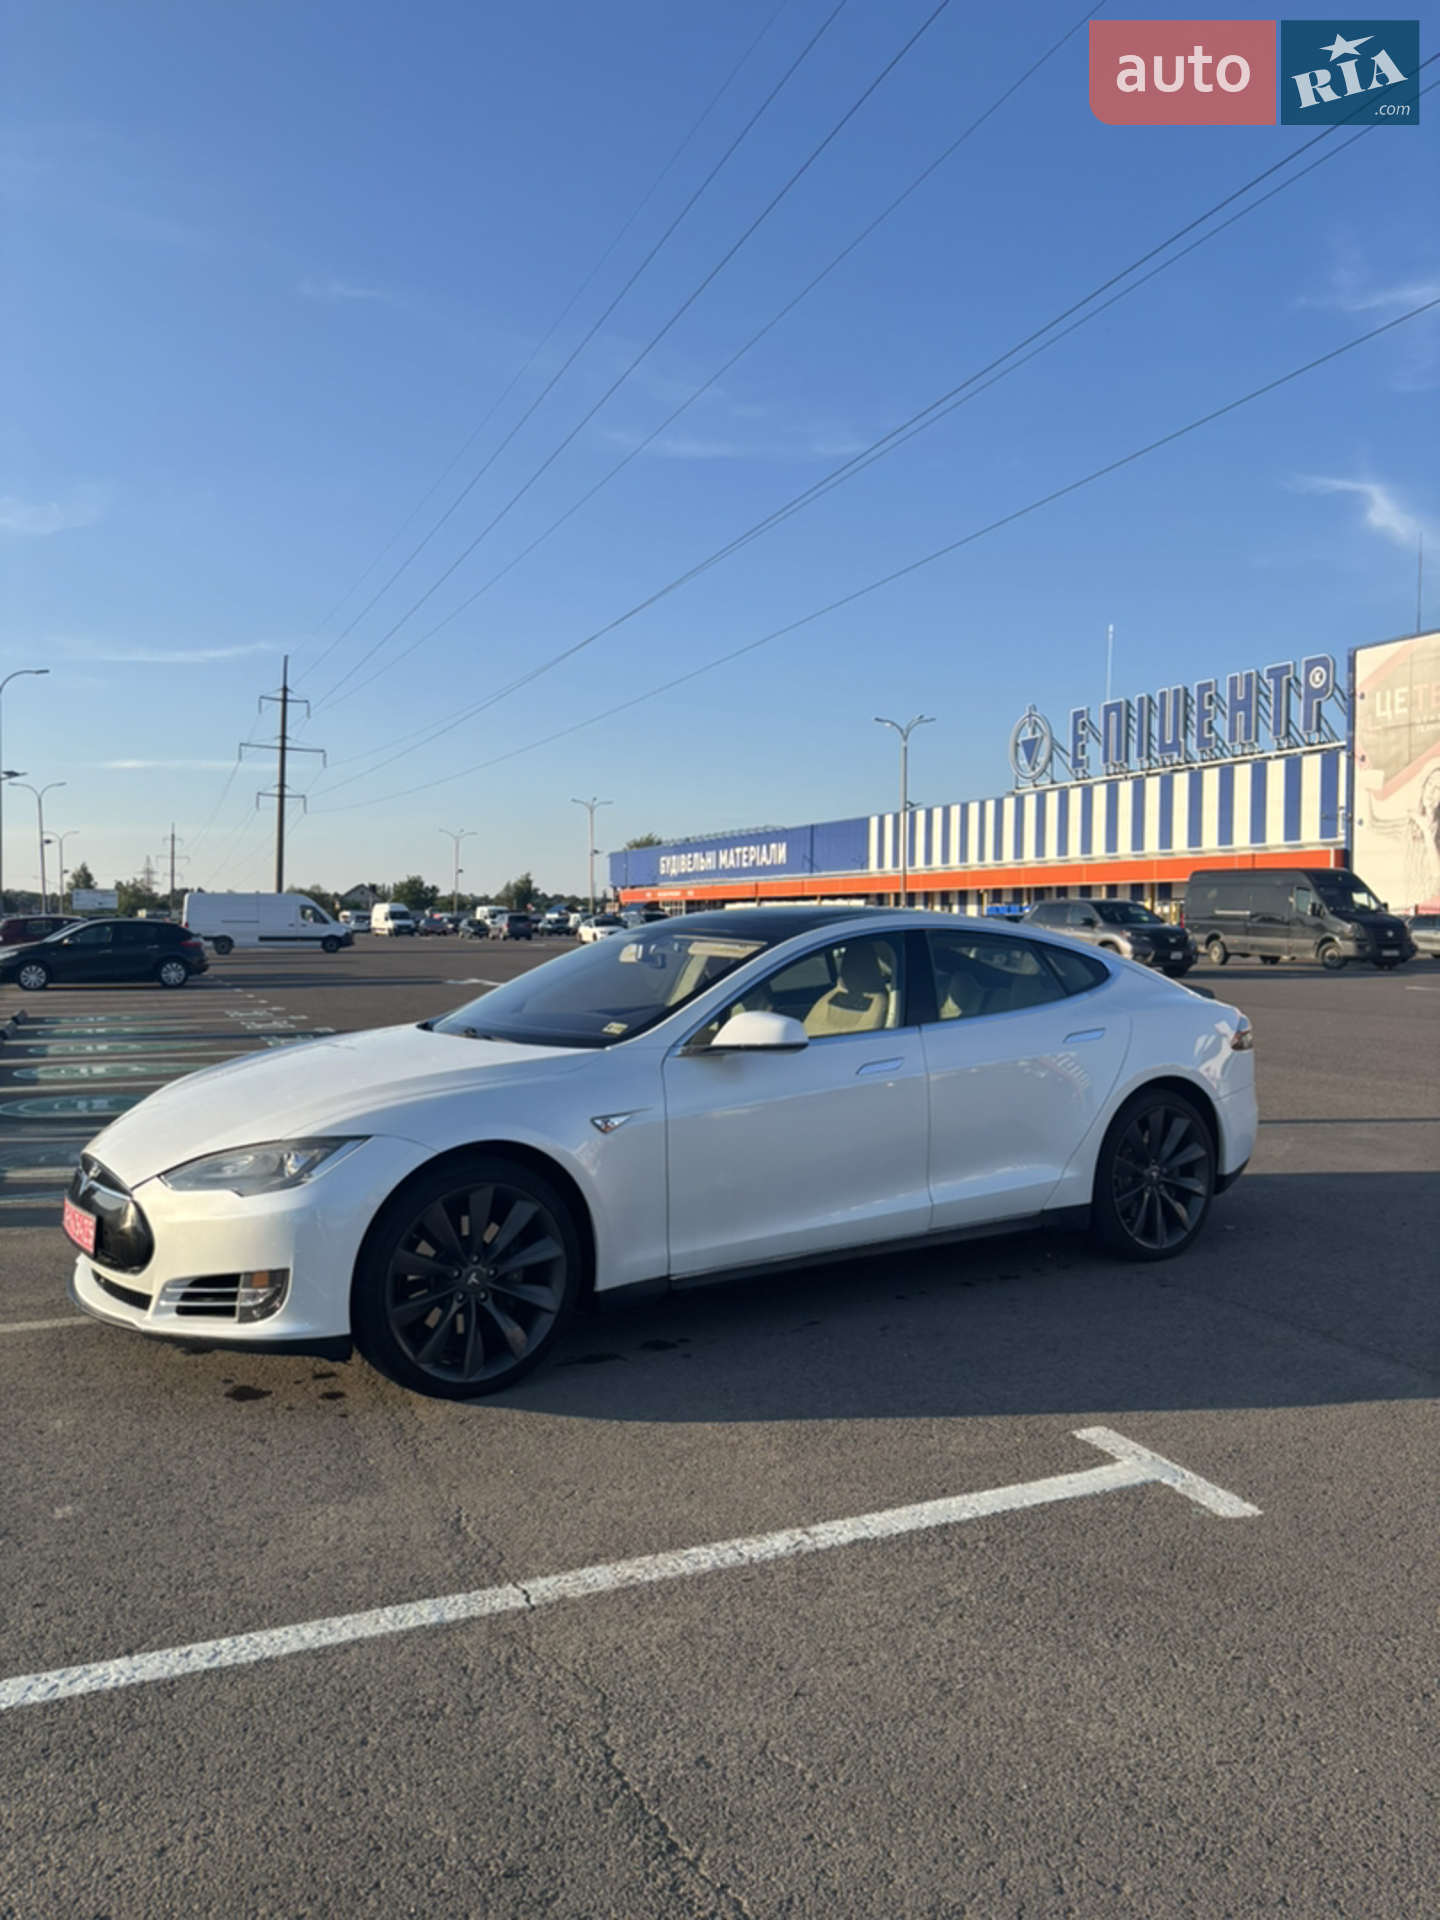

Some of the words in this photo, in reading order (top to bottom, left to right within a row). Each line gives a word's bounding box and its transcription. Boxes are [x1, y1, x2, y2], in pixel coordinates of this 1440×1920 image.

[1070, 653, 1335, 771] ЕПІЦЕНТР
[1376, 686, 1409, 720] ЦЕ
[659, 850, 717, 877] БУДІВЕЛЬНІ
[719, 842, 787, 870] МАТЕРІАЛИ
